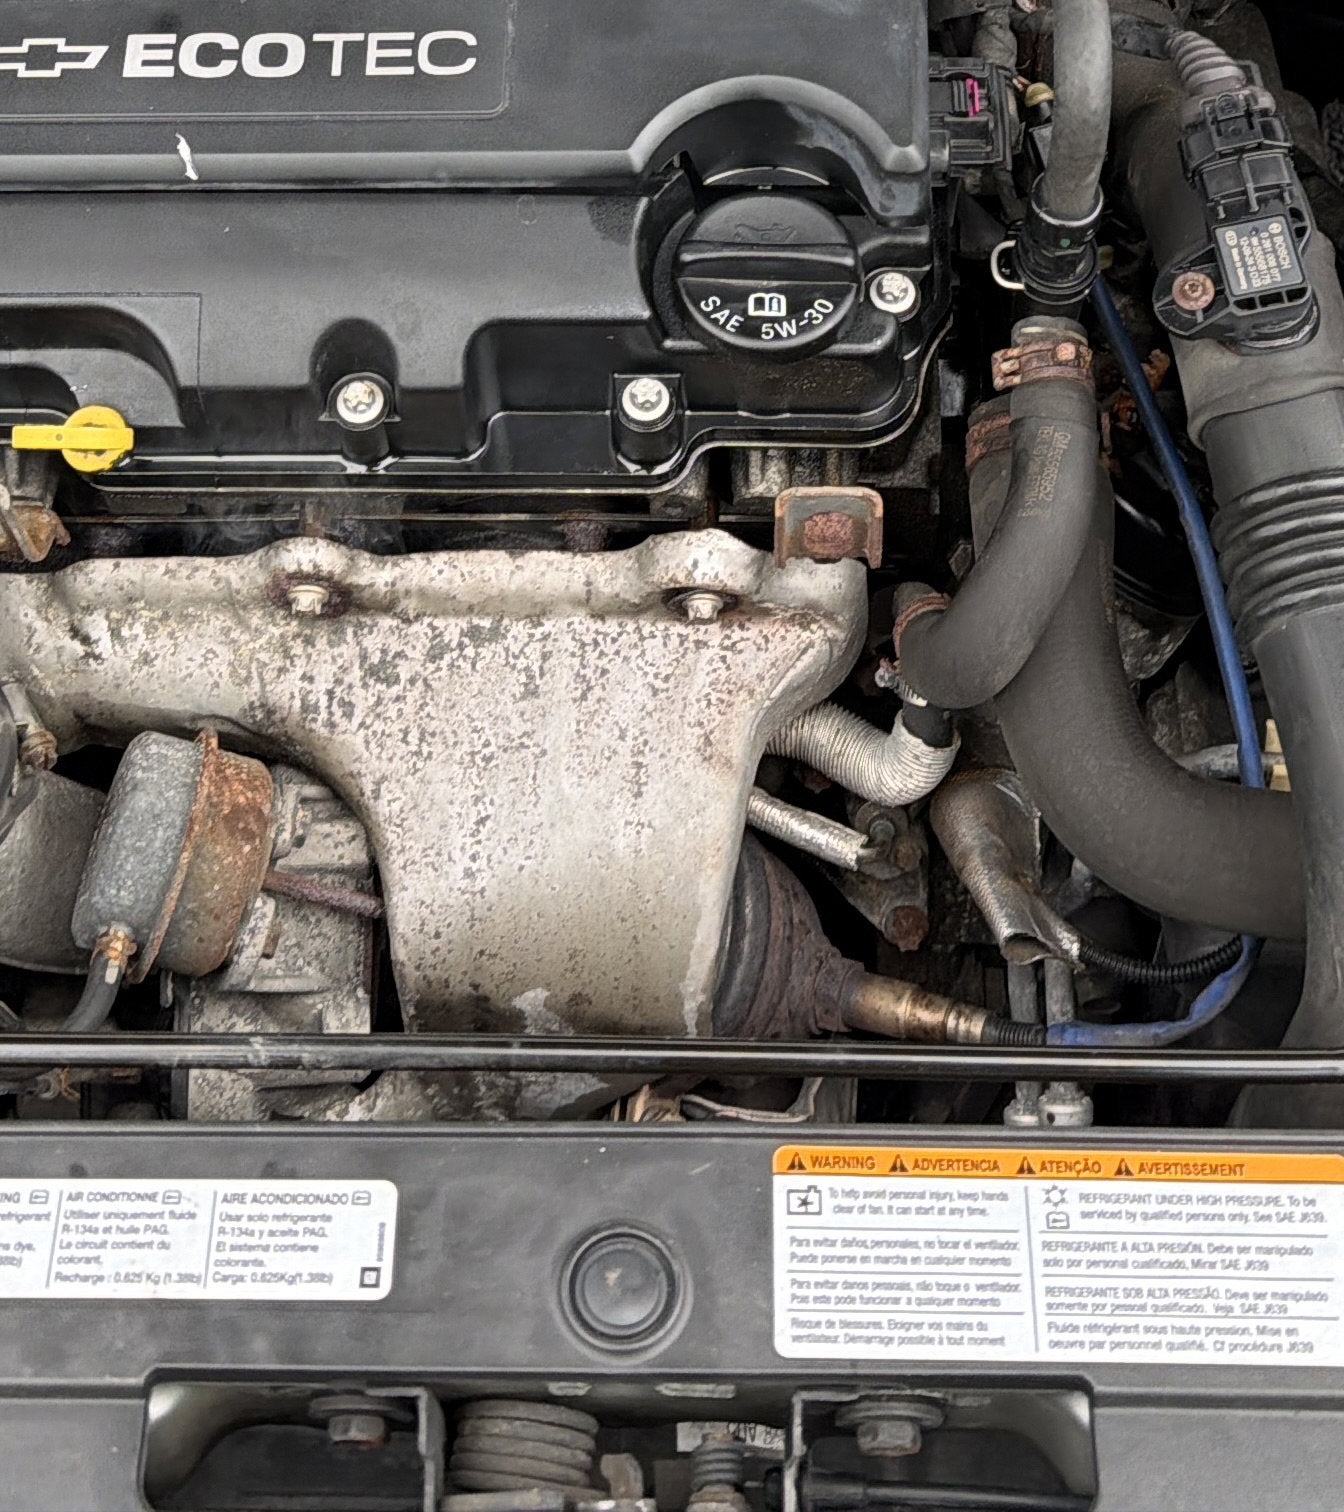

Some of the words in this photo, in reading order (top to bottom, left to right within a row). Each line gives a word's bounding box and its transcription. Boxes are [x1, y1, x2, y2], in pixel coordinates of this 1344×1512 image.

[121, 30, 478, 79] ECOTEC
[1273, 236, 1292, 269] BOSCH
[700, 295, 745, 333] SAE
[760, 297, 835, 340] 5W-30
[810, 1155, 876, 1170] WARNING
[912, 1158, 1000, 1172] ADVERTENCIA
[1040, 1158, 1101, 1178] ATENÇÃO
[1138, 1163, 1246, 1176] AVERTISSEMENT
[221, 1193, 247, 1204] AIRE
